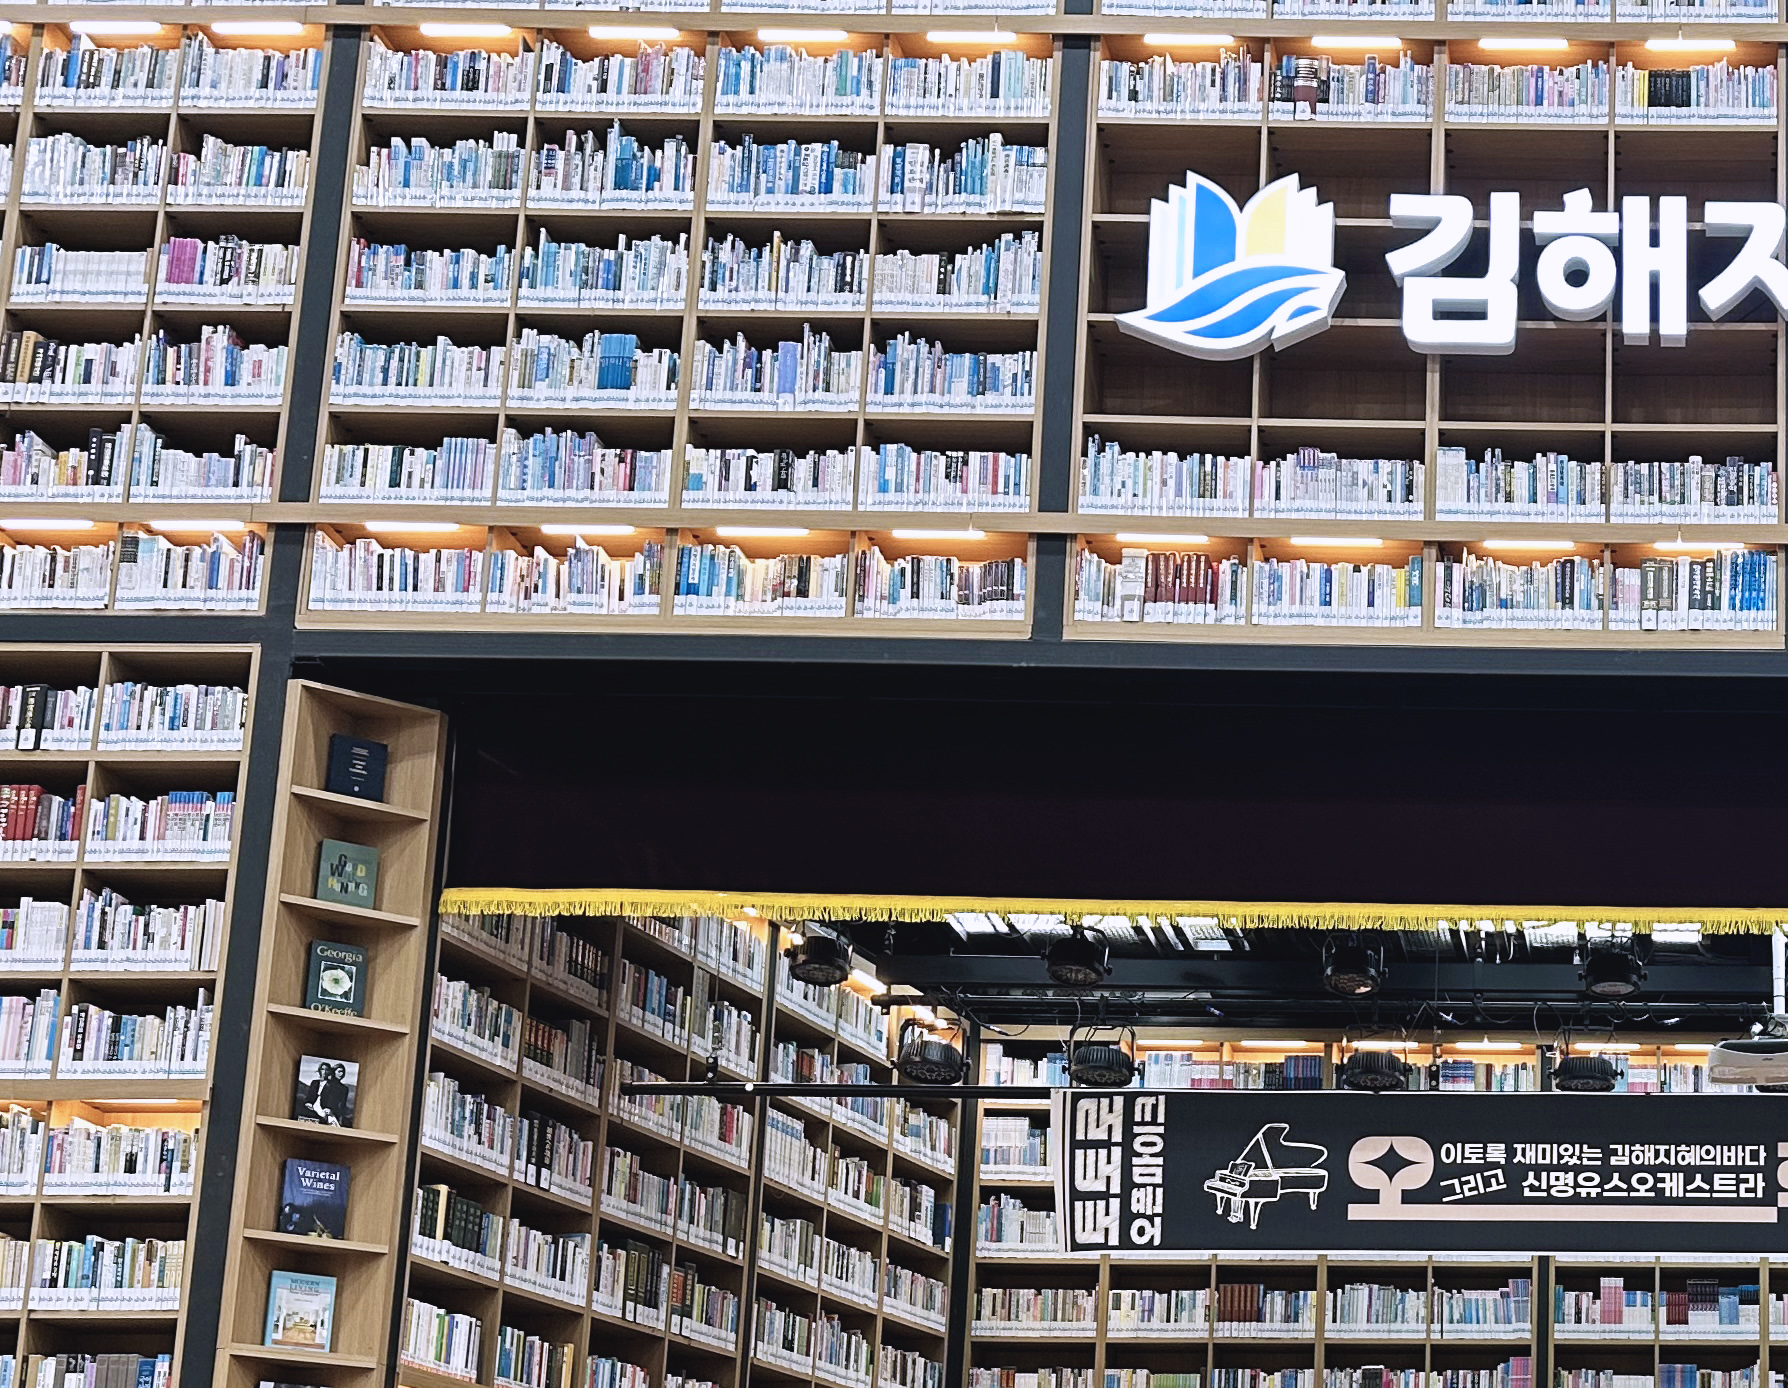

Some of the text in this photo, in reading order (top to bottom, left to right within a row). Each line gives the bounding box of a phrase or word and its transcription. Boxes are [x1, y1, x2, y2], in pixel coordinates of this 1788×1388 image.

[317, 946, 363, 963] Georgia
[1440, 1143, 1767, 1167] 이토록 재미있는 김해지혜의바다
[298, 1167, 340, 1180] Varietal
[1074, 1095, 1125, 1246] 토토로
[1130, 1095, 1166, 1246] 오픈마이크
[301, 1178, 335, 1190] Wines
[1439, 1168, 1766, 1203] 그리고 신명유스오케스트라
